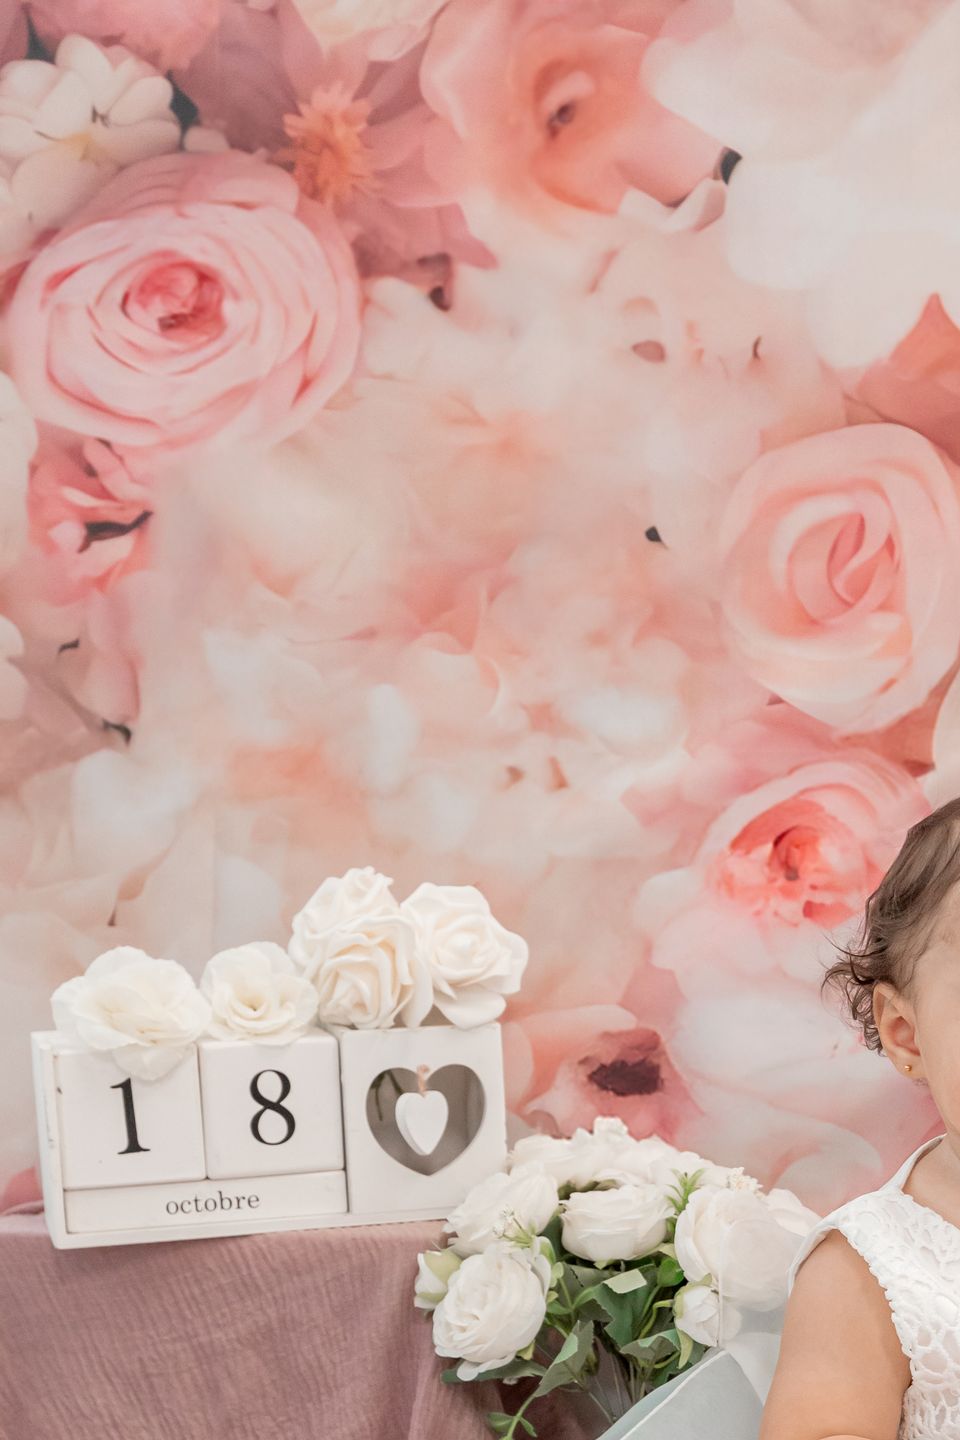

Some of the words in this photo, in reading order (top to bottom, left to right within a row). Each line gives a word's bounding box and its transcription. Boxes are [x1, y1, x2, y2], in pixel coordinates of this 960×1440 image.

[110, 1077, 151, 1155] 1
[249, 1069, 296, 1146] 8
[166, 1190, 260, 1215] octobre
